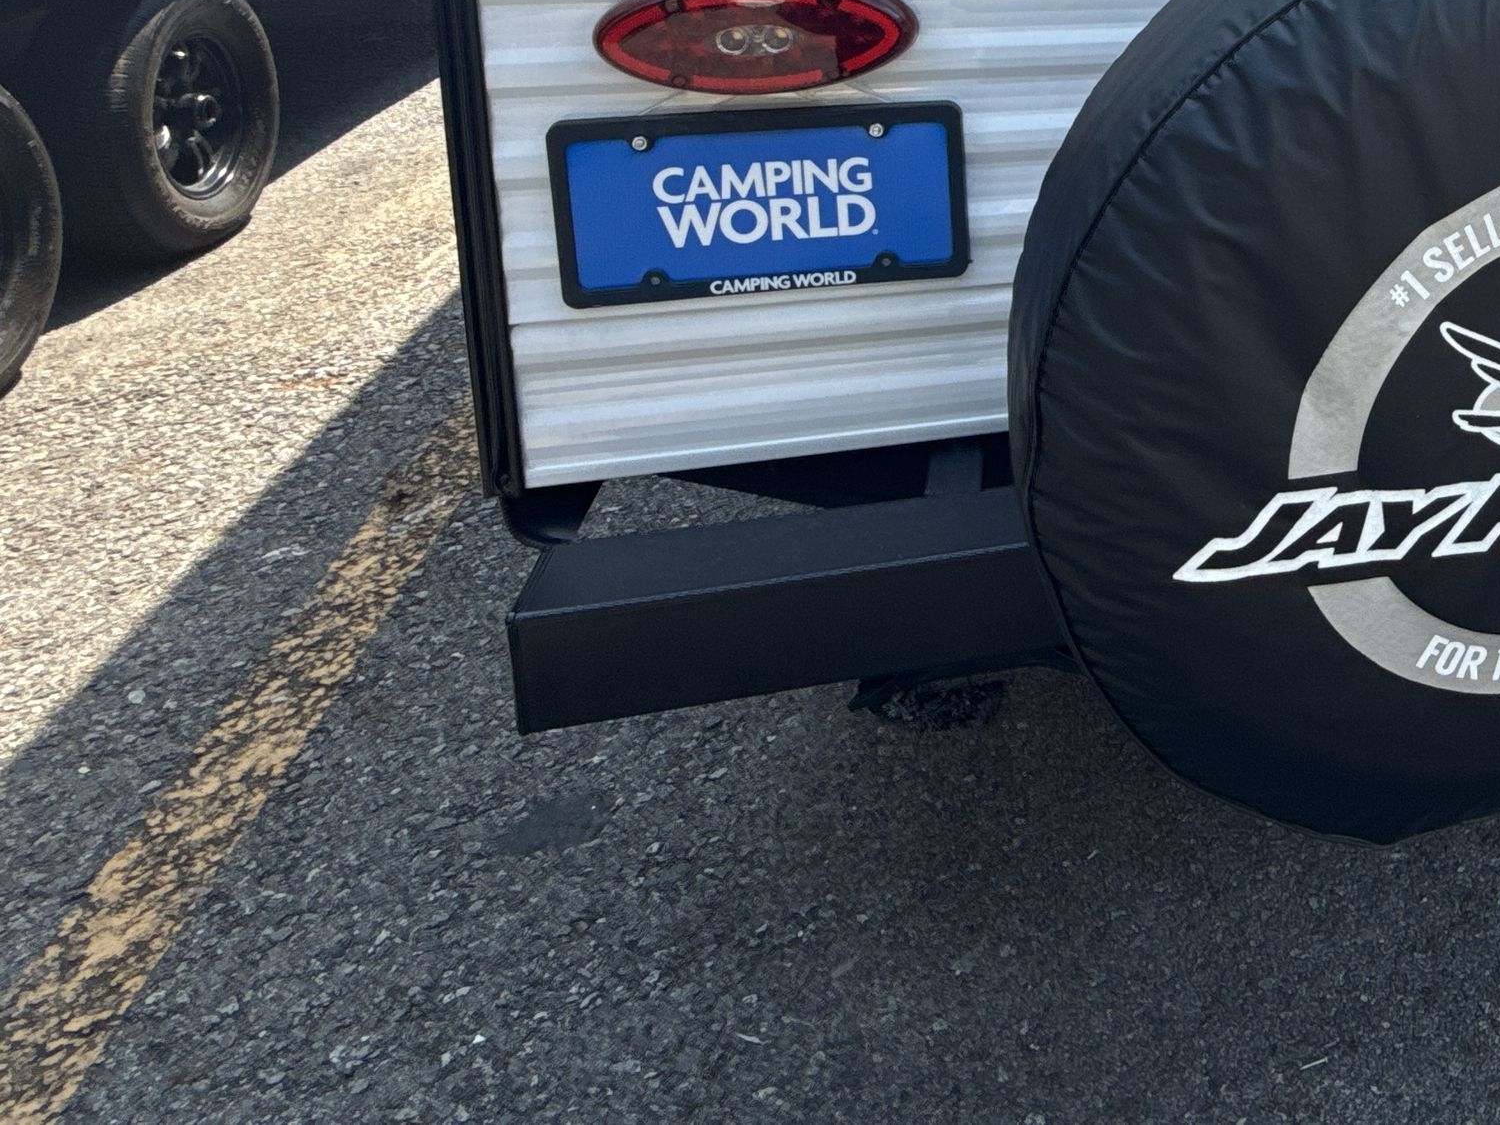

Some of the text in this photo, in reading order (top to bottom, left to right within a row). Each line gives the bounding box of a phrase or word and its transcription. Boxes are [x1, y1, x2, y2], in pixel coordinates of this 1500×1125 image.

[652, 156, 873, 204] CAMPING
[656, 194, 877, 248] WORLD
[710, 270, 857, 295] CAMPING WORLD
[1389, 270, 1430, 308] #1
[1416, 634, 1488, 681] FOR
